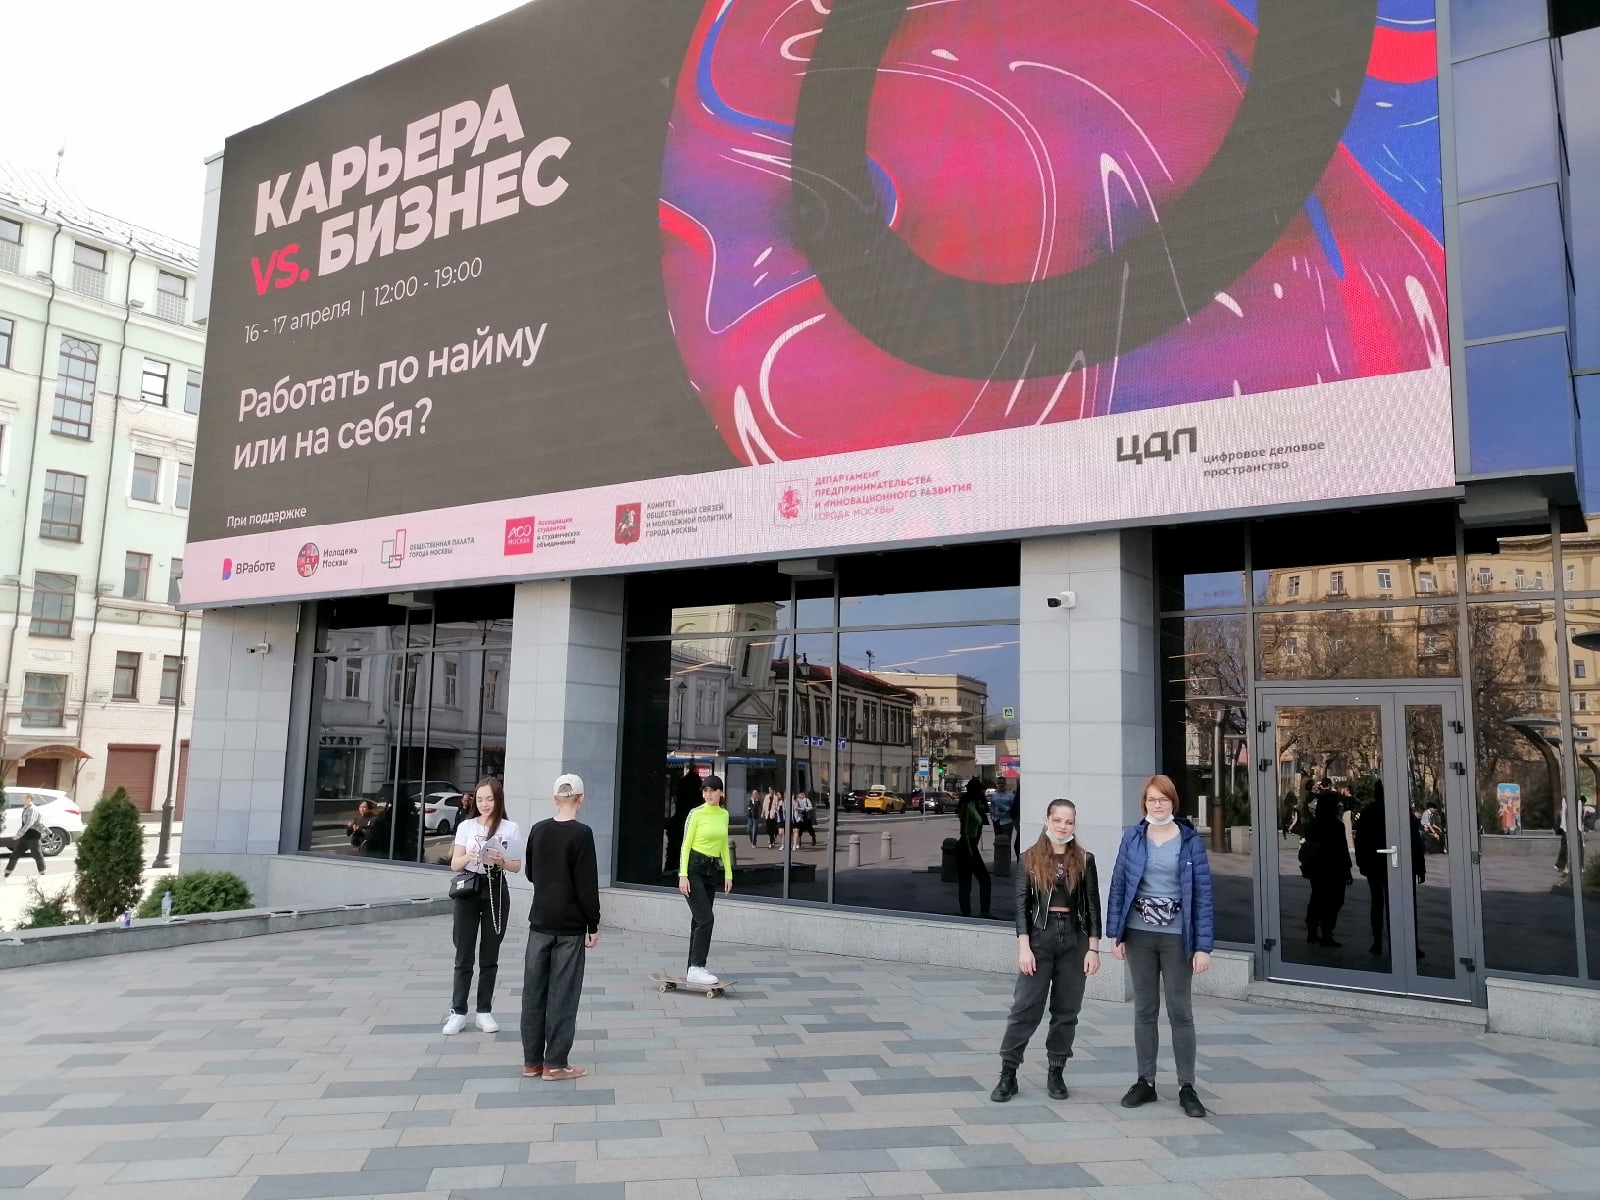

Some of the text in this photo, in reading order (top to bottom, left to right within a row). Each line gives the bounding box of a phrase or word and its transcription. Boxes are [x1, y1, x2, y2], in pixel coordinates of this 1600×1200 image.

[254, 83, 525, 236] КАРЬЕРА
[251, 136, 572, 296] VS. БИЗНЕС
[244, 323, 260, 344] 16
[273, 315, 287, 336] 17
[290, 299, 351, 329] апреля
[374, 276, 418, 307] 12:00
[434, 257, 483, 289] 19:00
[238, 322, 548, 422] Работать по найму
[233, 397, 433, 470] или на себя?
[1203, 441, 1325, 466] цифровое деловое
[1203, 460, 1289, 478] пространство
[815, 470, 880, 486] ДЕПАРТАМЕНТ
[815, 475, 932, 497] ПРЕДПРИНИМАТЕЛЬСТВА
[824, 490, 916, 508] ИННОВАЦИОННОГО
[921, 483, 972, 497] РАЗВИТИЯ
[646, 503, 724, 519] ОБЩЕСТВЕННЫХ СВЯЗЕЙ
[647, 500, 675, 509] КОМИТЕТ
[227, 506, 307, 529] При поддержке
[538, 517, 573, 525] Ассоциация
[698, 512, 733, 524] ПОЛИТИКИ
[815, 506, 894, 521] ГОРОДА МОСКВЫ
[537, 525, 566, 533] студентов
[646, 526, 698, 538] ГОРОДА МОСКВЫ
[409, 537, 475, 551] ОБЩЕСТВЕННАЯ ПАЛАТА
[536, 538, 576, 548] объединений
[409, 547, 453, 558] ГОРОДА МОСКВЫ
[236, 560, 276, 575] ВРаботе
[322, 559, 349, 568] Москвы
